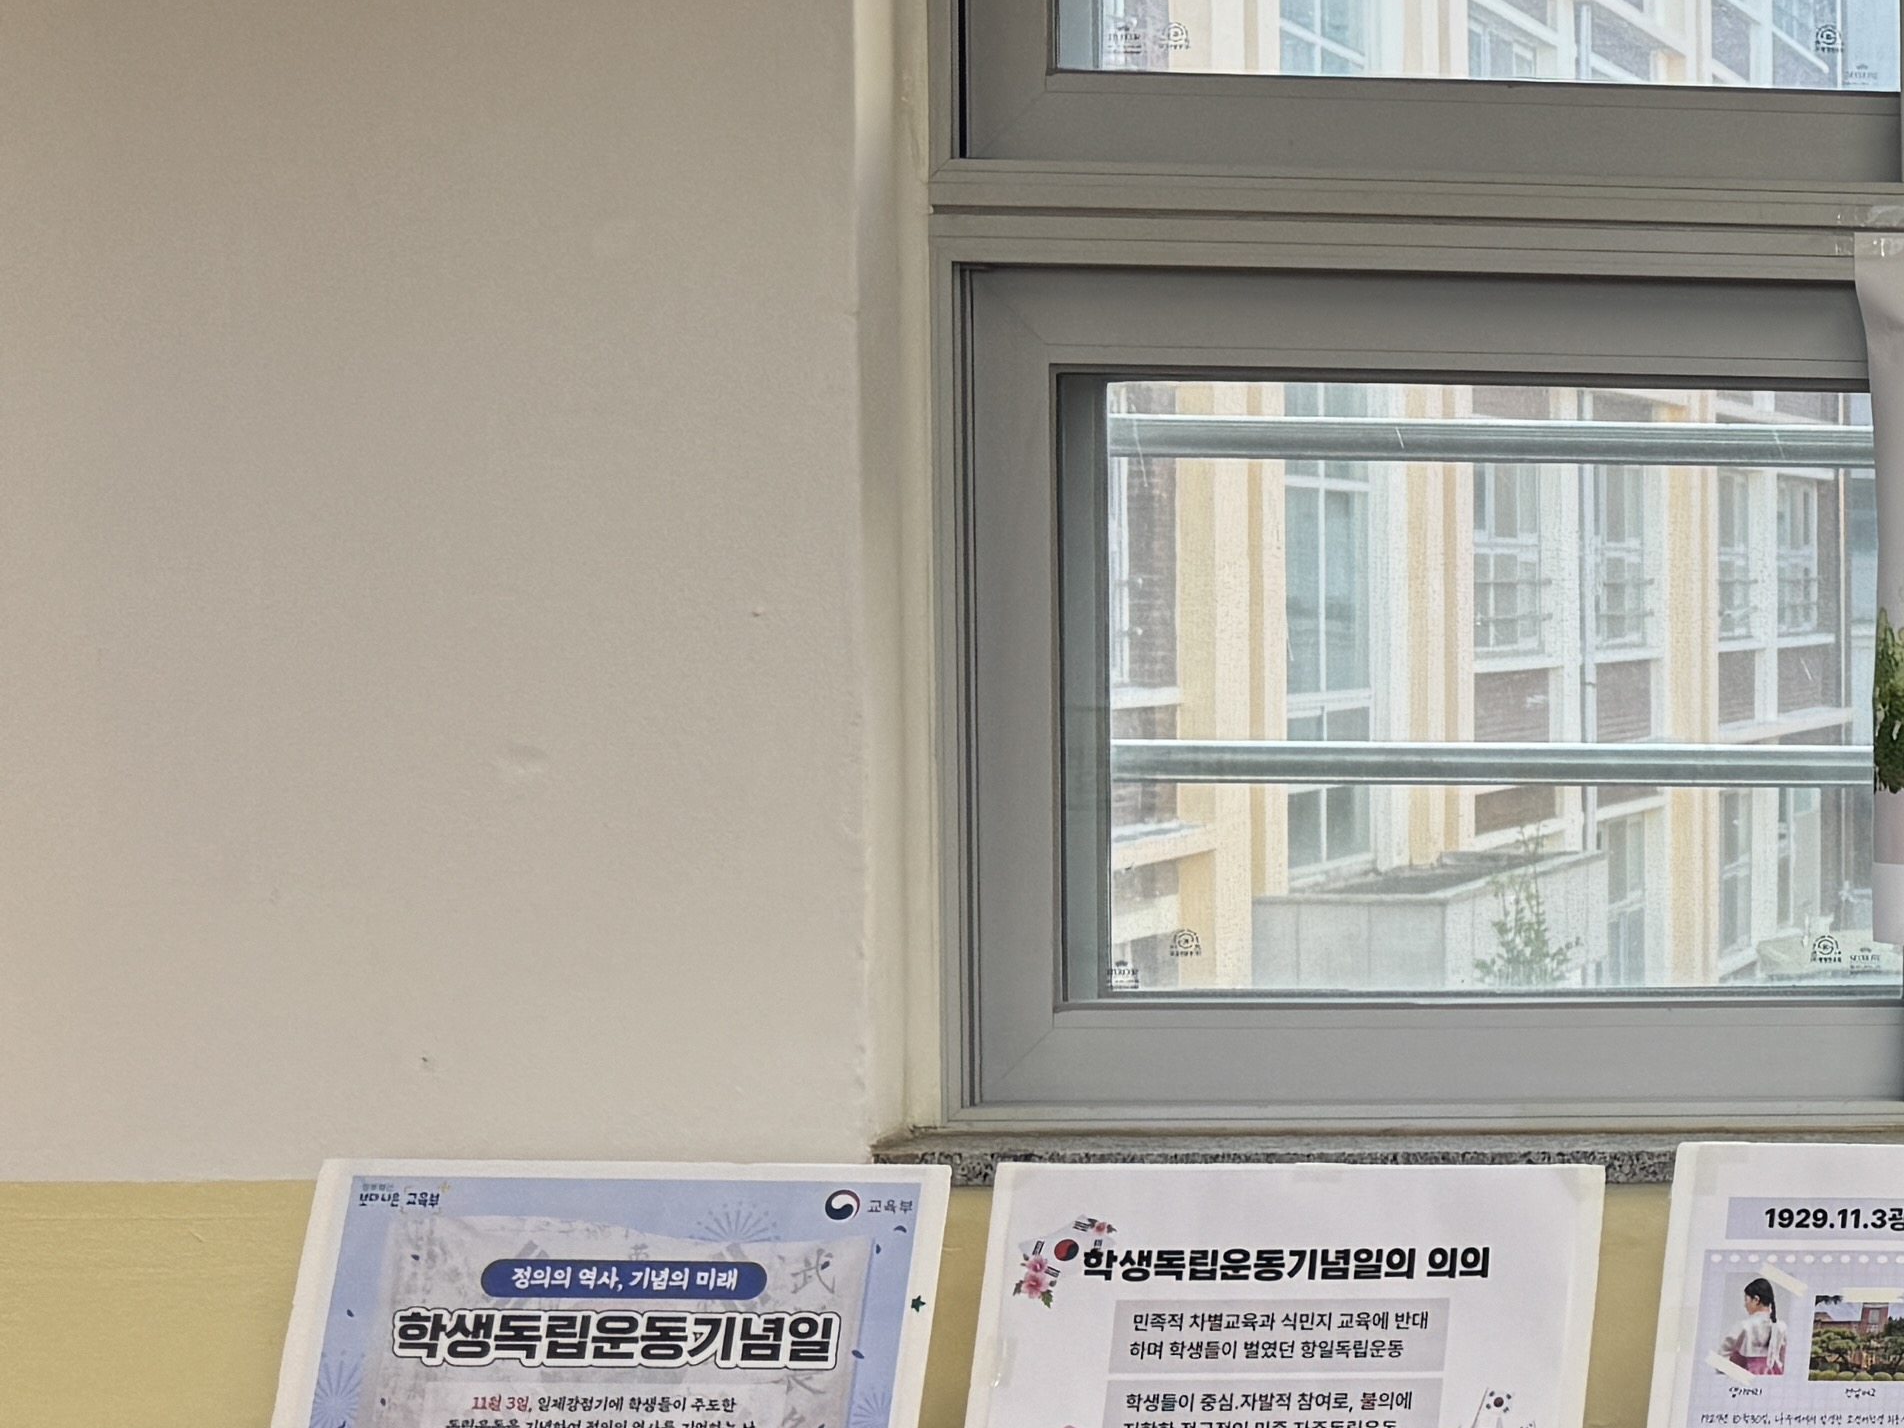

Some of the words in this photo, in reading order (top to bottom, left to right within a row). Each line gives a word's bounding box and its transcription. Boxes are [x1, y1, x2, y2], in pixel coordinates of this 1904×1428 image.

[867, 1199, 913, 1214] 교육부
[1083, 1247, 1415, 1282] 학생독립운동기념일의
[1426, 1246, 1490, 1279] 의의
[511, 1266, 572, 1290] 정의의
[578, 1266, 624, 1292] 역사,
[630, 1267, 690, 1291] 기념의
[697, 1268, 738, 1291] 미래
[1133, 1313, 1184, 1332] 민족적
[1189, 1312, 1275, 1332] 차별교육과
[1281, 1312, 1332, 1331] 식민지
[1337, 1311, 1389, 1330] 교육에
[1394, 1311, 1429, 1331] 반대
[395, 1309, 837, 1365] 학생독립운동기념일
[1129, 1341, 1164, 1360] 하며
[1169, 1341, 1237, 1359] 학생들이
[1244, 1341, 1295, 1359] 벌였던
[1301, 1340, 1404, 1359] 항일독립운동
[472, 1395, 502, 1413] 11월
[505, 1396, 534, 1414] 3일,
[537, 1396, 624, 1413] 일제강점기에
[629, 1397, 687, 1413] 학생들이
[691, 1398, 737, 1414] 주도한
[1126, 1393, 1194, 1412] 학생들이
[1297, 1392, 1353, 1411] 참여로,
[1359, 1391, 1412, 1410] 불의에
